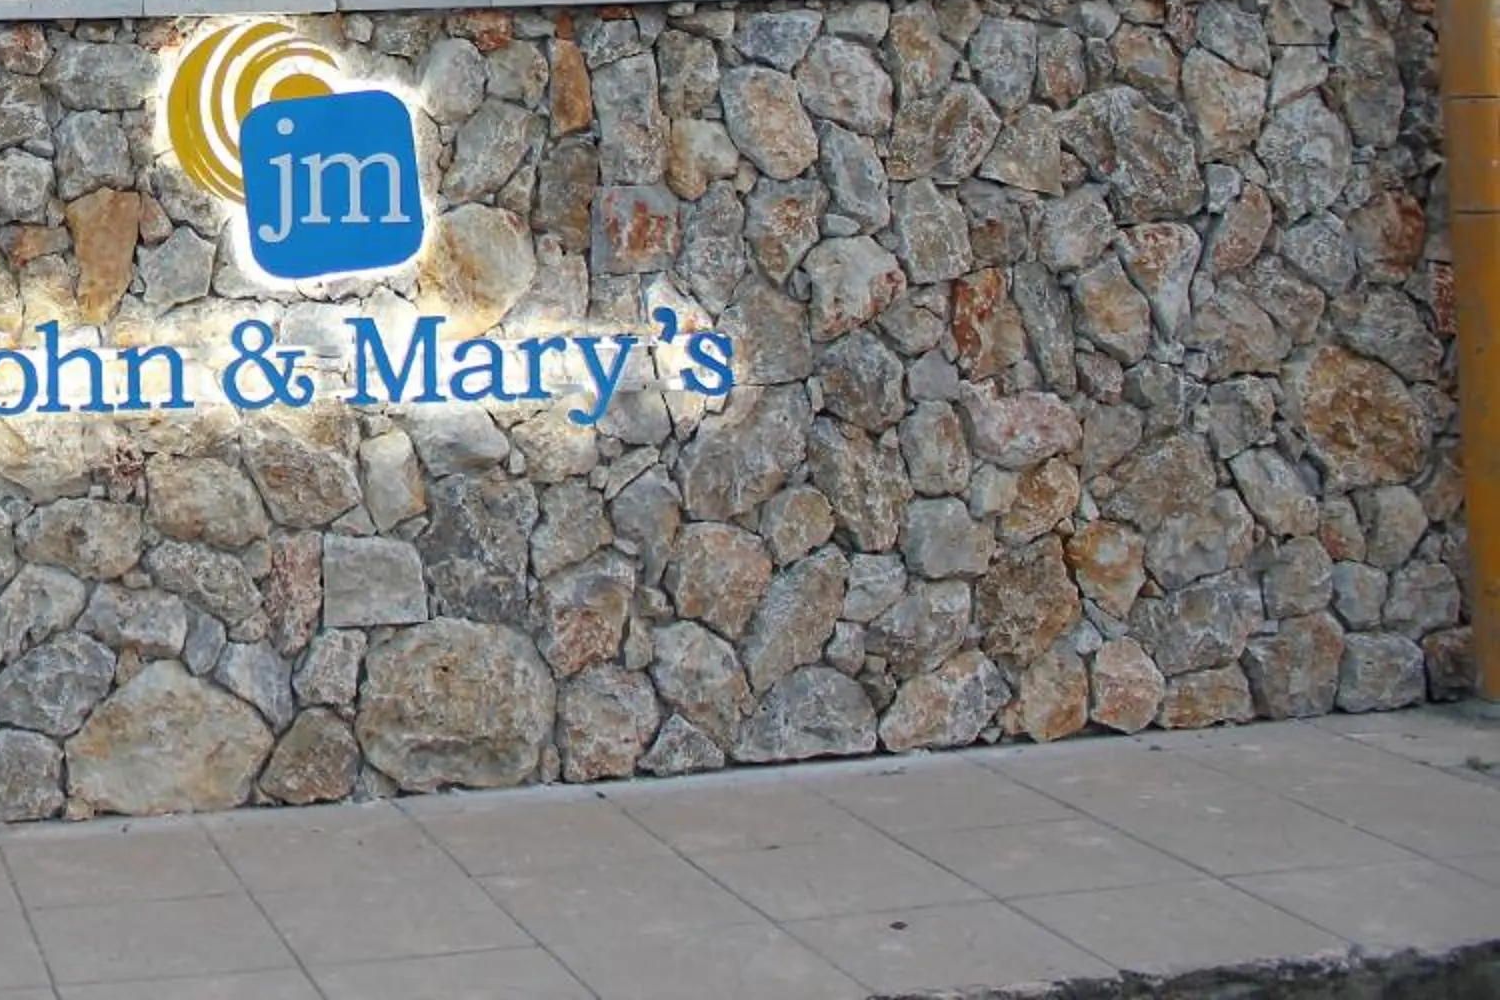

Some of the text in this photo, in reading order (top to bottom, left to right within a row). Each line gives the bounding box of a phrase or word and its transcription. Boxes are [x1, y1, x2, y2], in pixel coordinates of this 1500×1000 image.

[258, 117, 412, 243] jm
[222, 319, 316, 410] &
[344, 306, 735, 425] Mary's
